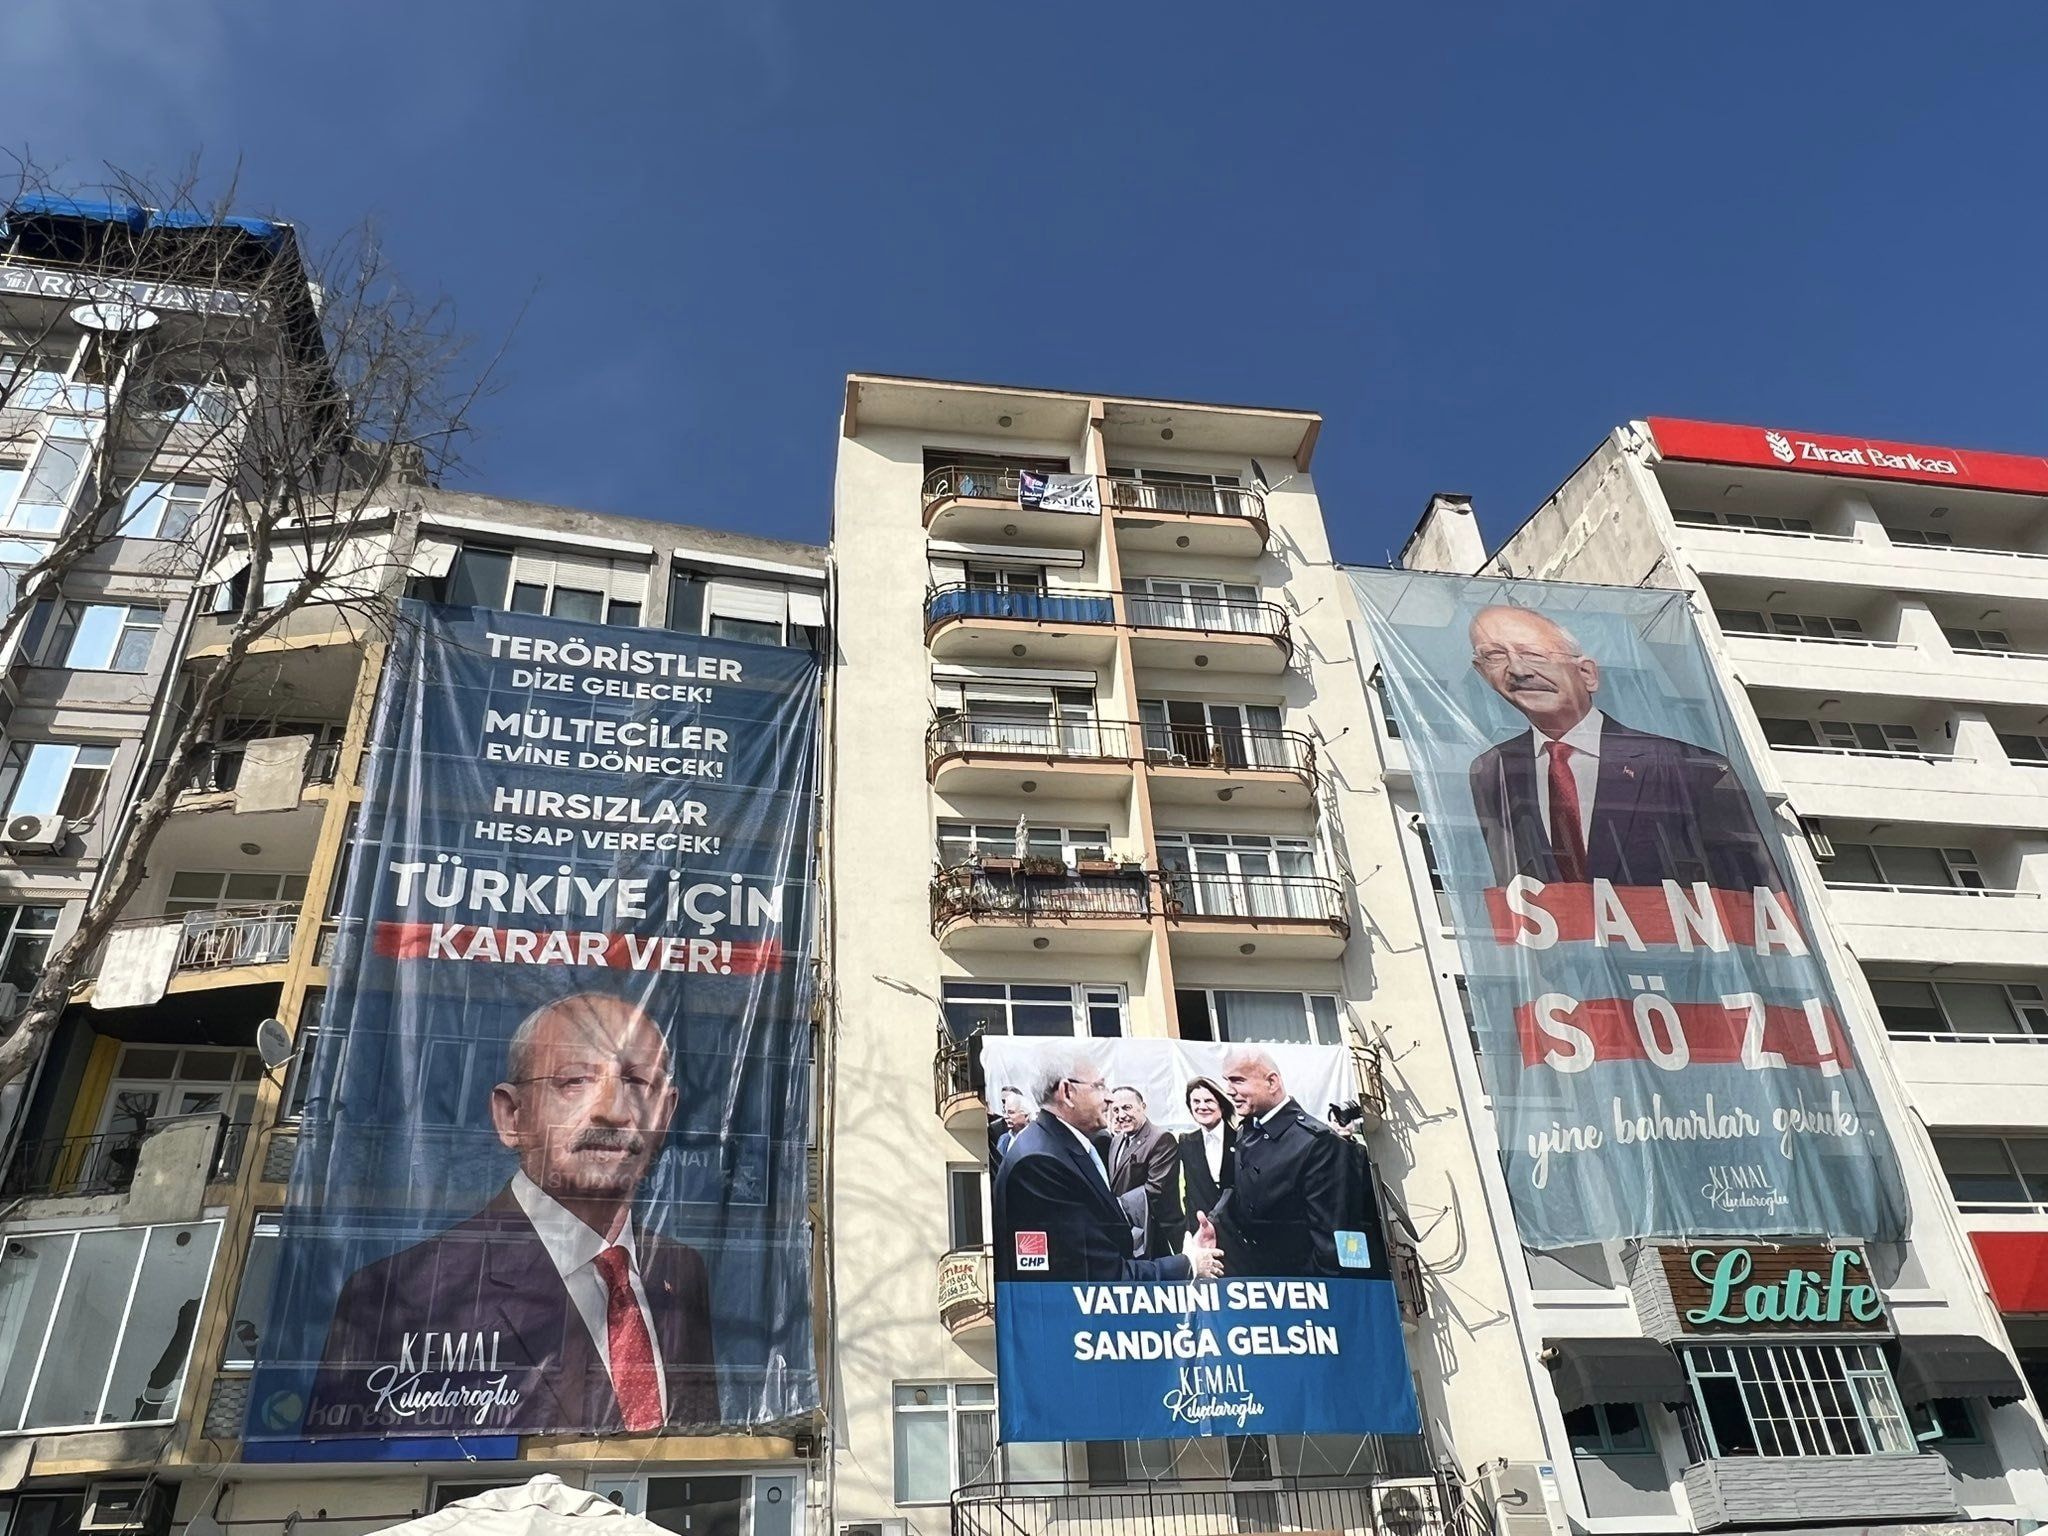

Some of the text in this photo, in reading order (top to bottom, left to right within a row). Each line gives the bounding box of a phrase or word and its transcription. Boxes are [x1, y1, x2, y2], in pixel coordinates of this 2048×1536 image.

[1796, 441, 1958, 475] Ziraat Bankası
[485, 631, 743, 683] TERÖRİSTLER
[511, 667, 713, 704] DİZE GELECEK!
[485, 708, 729, 754] MÜLTECİLER
[486, 741, 724, 779] EVİNE DÖNECEK!
[493, 786, 708, 827] HIRSIZLAR
[474, 820, 721, 855] HESAP VERECEK!
[389, 853, 785, 936] TÜRKİYE İÇİN
[1505, 873, 1812, 959] SANA
[427, 923, 733, 975] KARAR VER!
[1533, 973, 1843, 1078] SÖZ!
[1528, 1119, 1603, 1190] yine
[1612, 1092, 1760, 1145] baharlar
[1708, 1164, 1773, 1190] KEMAL
[1020, 1256, 1046, 1268] CHP
[1072, 1280, 1330, 1316] VATANINI SEVEN
[1685, 1247, 1885, 1325] Latife
[399, 1330, 503, 1375] KEMAL
[1073, 1319, 1340, 1361] SANDIĞA GELSİN
[1179, 1363, 1250, 1396] KEMAL
